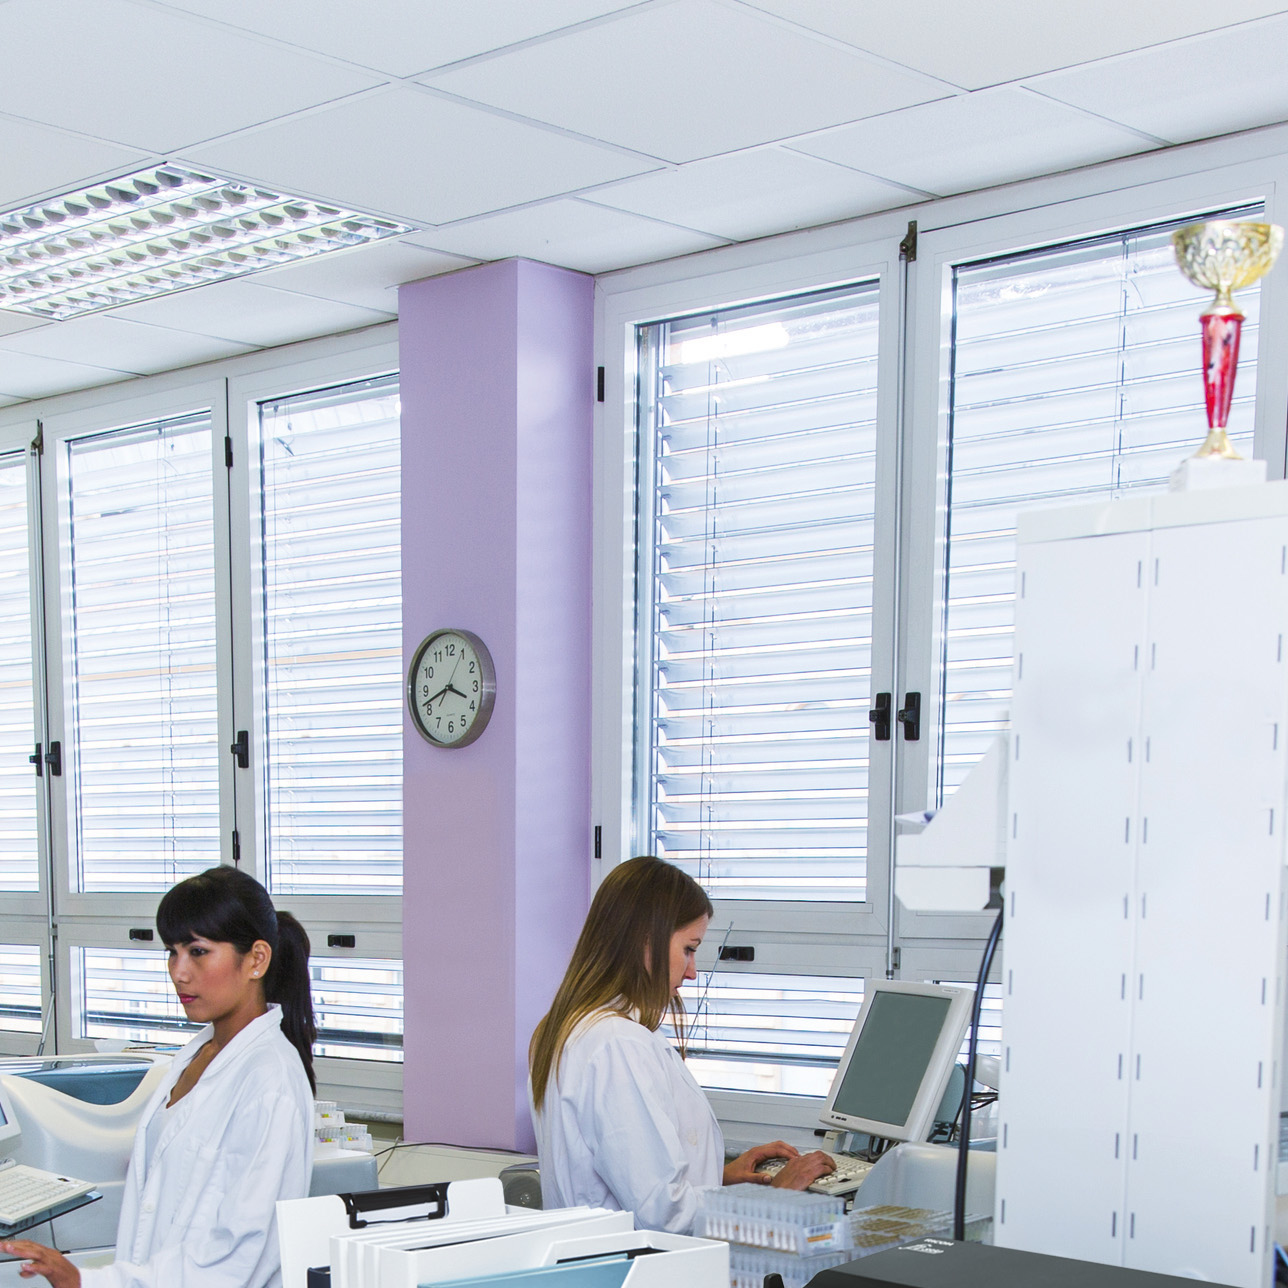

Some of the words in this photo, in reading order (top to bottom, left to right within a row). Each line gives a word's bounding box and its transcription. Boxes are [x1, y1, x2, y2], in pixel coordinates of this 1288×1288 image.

[445, 644, 455, 656] 12
[460, 648, 465, 660] 1
[434, 651, 443, 663] 11
[424, 666, 434, 679] 10
[469, 661, 475, 673] 2
[423, 685, 429, 697] 9
[472, 680, 479, 692] 3
[426, 704, 433, 716] 8
[469, 700, 475, 712] 4
[436, 717, 442, 729] 7
[448, 721, 454, 733] 6
[460, 715, 467, 727] 5
